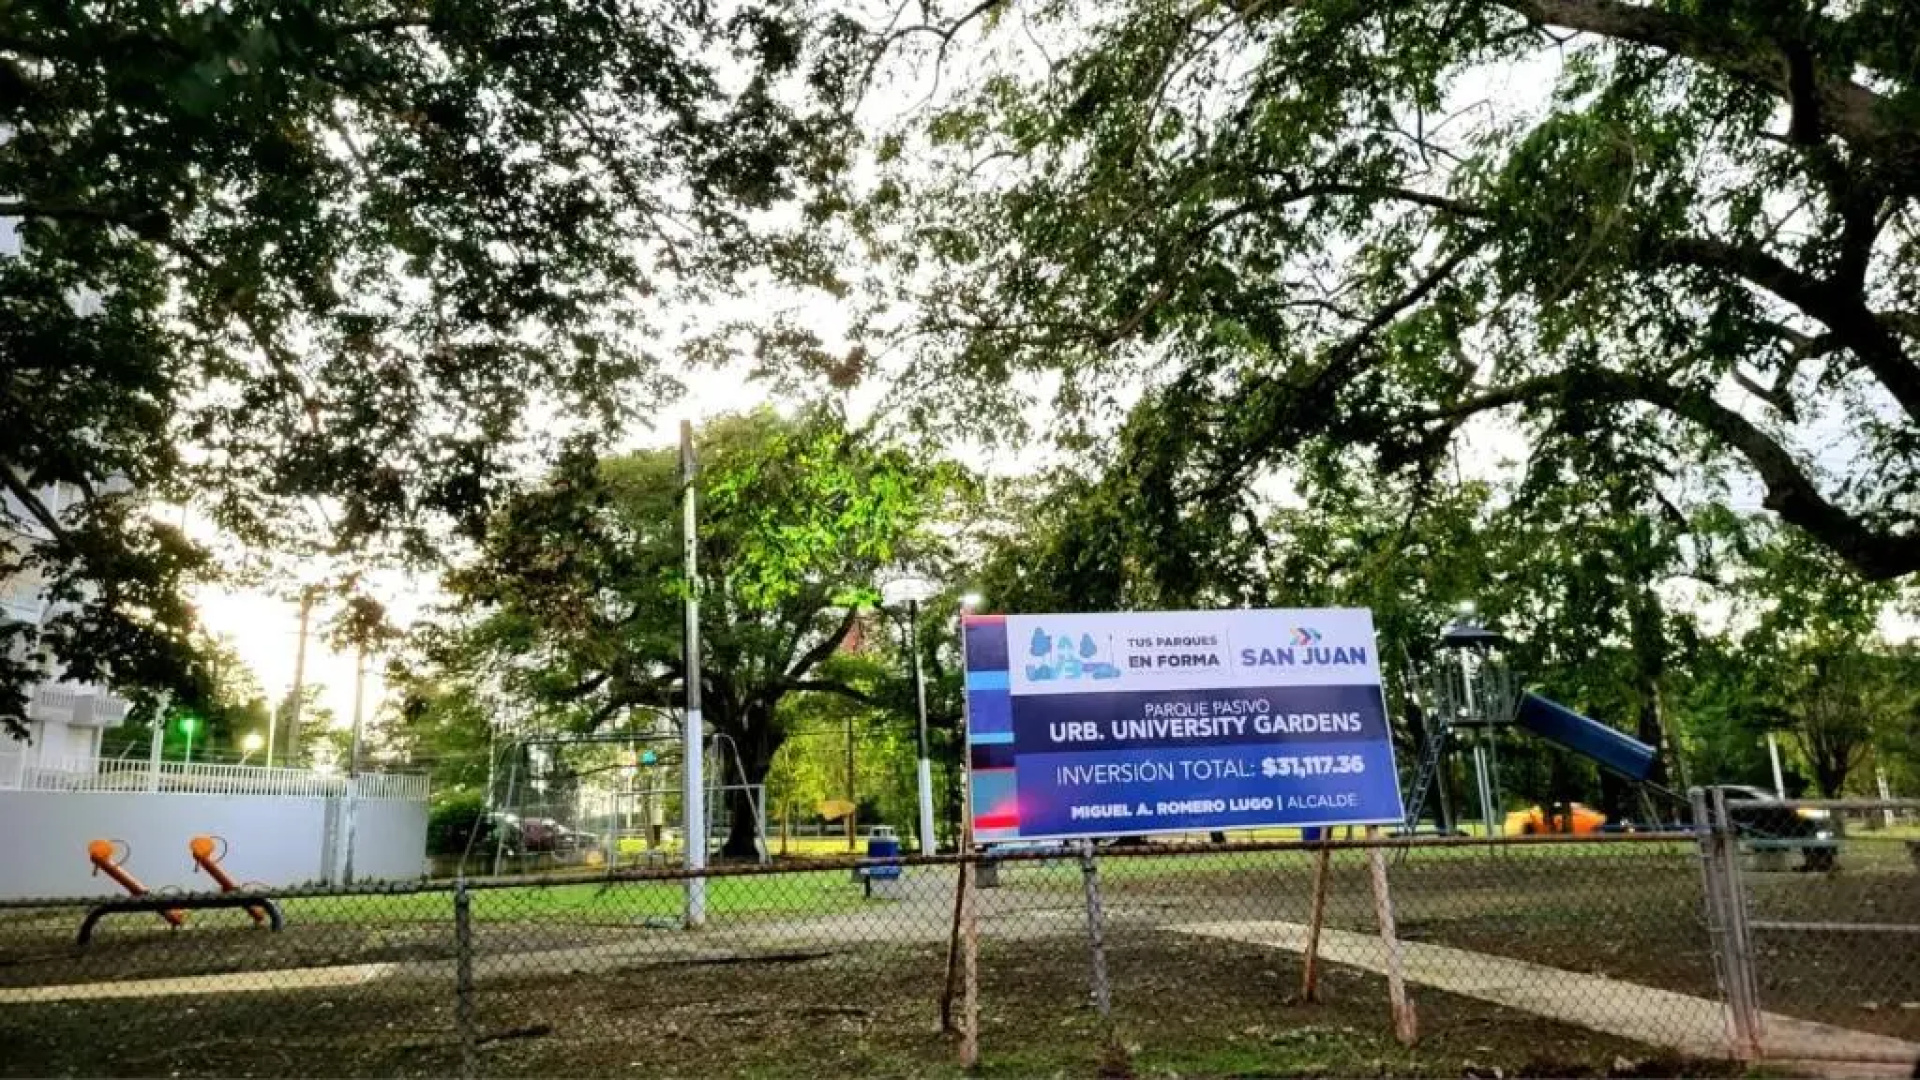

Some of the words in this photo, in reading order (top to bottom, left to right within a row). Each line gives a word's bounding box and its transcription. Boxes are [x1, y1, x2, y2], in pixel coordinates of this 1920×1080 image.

[1127, 637, 1153, 648] TUS
[1156, 635, 1218, 647] PARQUES
[1128, 655, 1152, 668] EN
[1157, 653, 1220, 668] FORMA
[1241, 648, 1295, 666] SAN
[1302, 646, 1367, 665] JUAN
[1145, 702, 1209, 717] PARQUE
[1212, 699, 1270, 714] PASIVO
[1050, 721, 1105, 742] URB.
[1111, 716, 1248, 739] UNIVERSITY
[1254, 712, 1362, 734] GARDENS
[1057, 759, 1174, 786] INVERSIÓN
[1179, 758, 1255, 781] TOTAL:
[1261, 755, 1365, 778] $31,117.36
[1070, 803, 1133, 820] MIGUEL
[1136, 802, 1153, 816] A.
[1157, 799, 1226, 816] ROMERO
[1230, 797, 1274, 812] LUGO
[1287, 793, 1359, 809] ALCALDE
